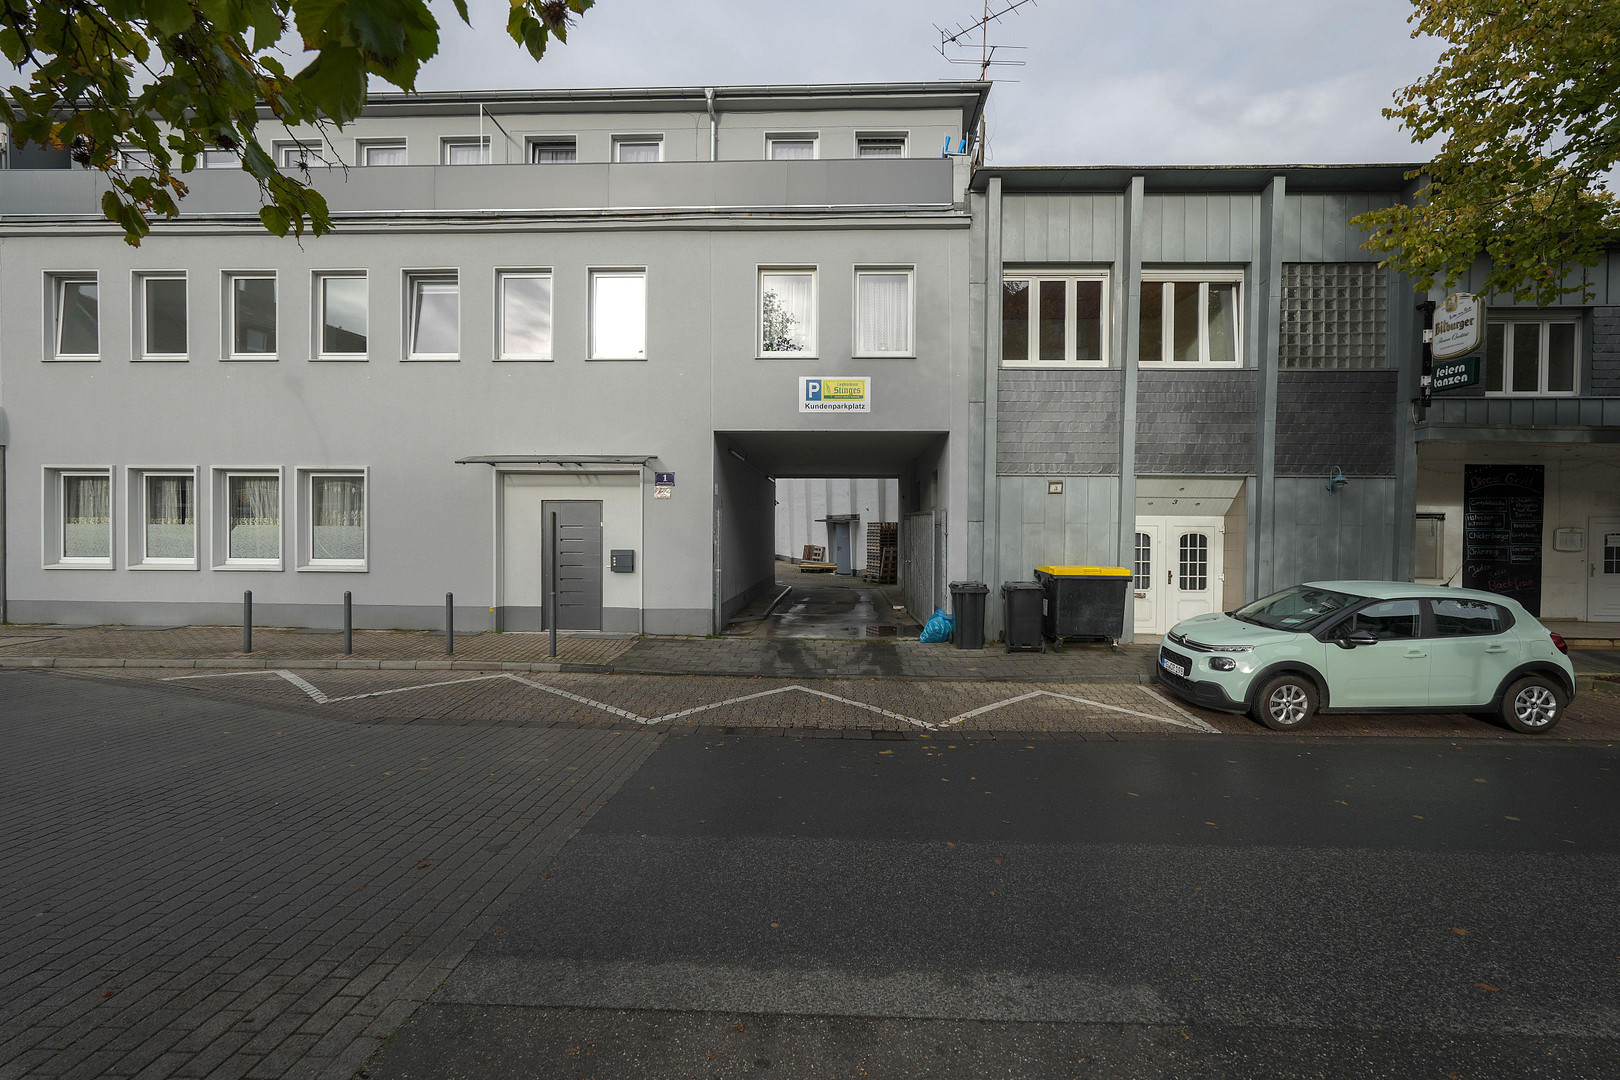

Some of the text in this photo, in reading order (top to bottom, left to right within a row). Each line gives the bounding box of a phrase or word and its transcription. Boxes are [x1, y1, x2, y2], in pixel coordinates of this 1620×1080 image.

[1435, 318, 1475, 336] Bitburger
[1436, 364, 1466, 378] feiern
[1433, 374, 1468, 388] tanzen
[808, 382, 820, 398] P
[833, 386, 861, 395] Stinges
[804, 403, 866, 411] Kundenparkplatz
